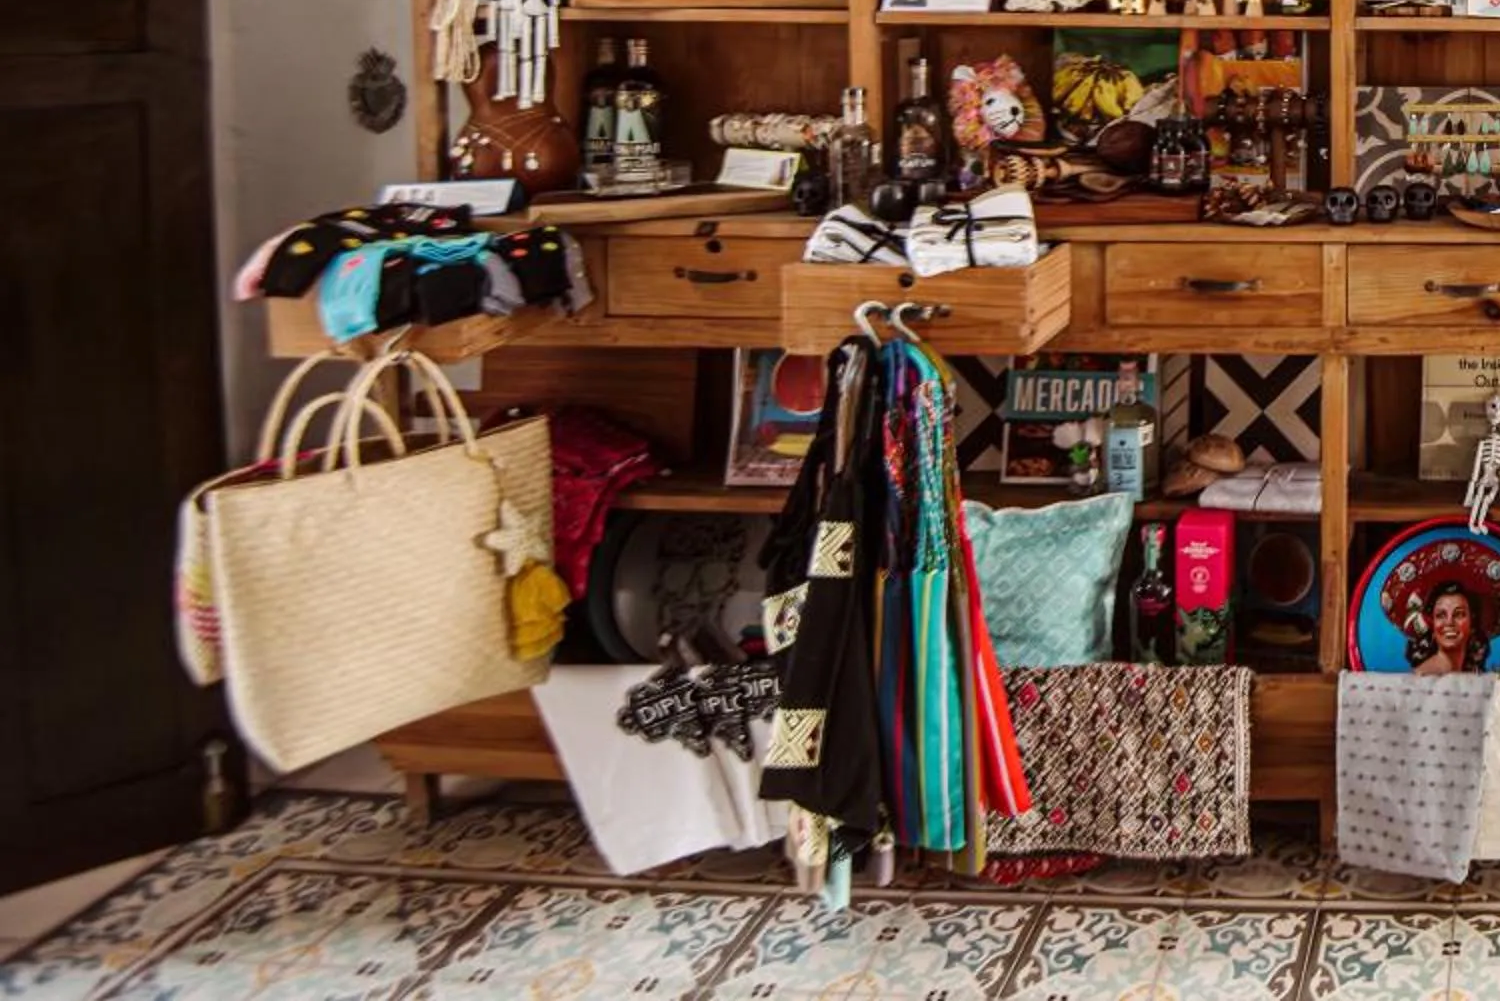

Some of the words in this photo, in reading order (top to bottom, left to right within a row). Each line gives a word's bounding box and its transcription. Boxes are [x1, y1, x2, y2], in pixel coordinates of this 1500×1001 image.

[1459, 358, 1478, 370] the
[1475, 374, 1499, 387] Out
[1013, 376, 1144, 412] MERCAD
